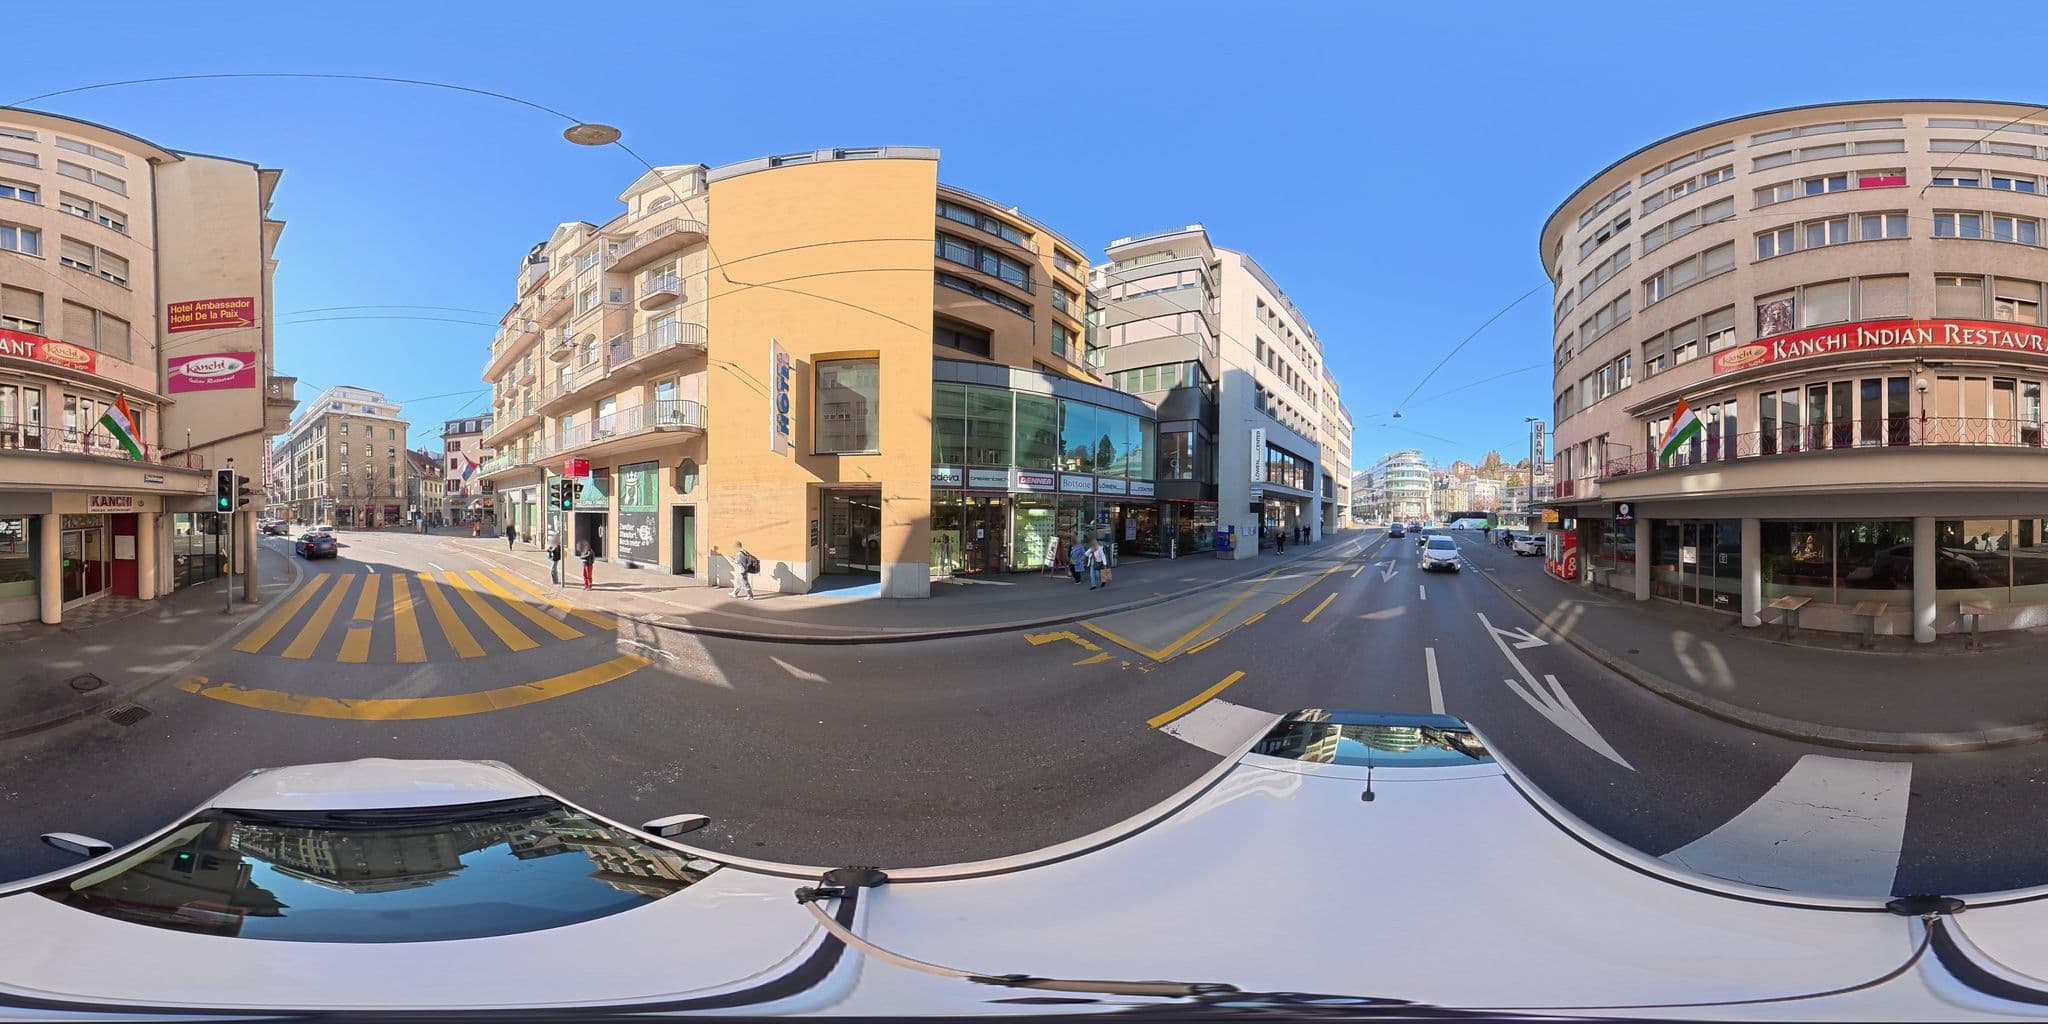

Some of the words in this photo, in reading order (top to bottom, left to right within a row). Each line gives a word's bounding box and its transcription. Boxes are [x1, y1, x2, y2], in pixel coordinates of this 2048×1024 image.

[170, 303, 193, 314] Hotel
[195, 301, 250, 311] Ambassador
[170, 313, 193, 324] Hotel
[195, 312, 208, 321] De
[210, 311, 218, 319] la
[220, 310, 239, 319] Paix
[1944, 324, 2048, 351] RESTAUR
[777, 353, 790, 435] HOTEL
[1020, 478, 1053, 486] DENNER
[91, 496, 133, 507] KANCHI
